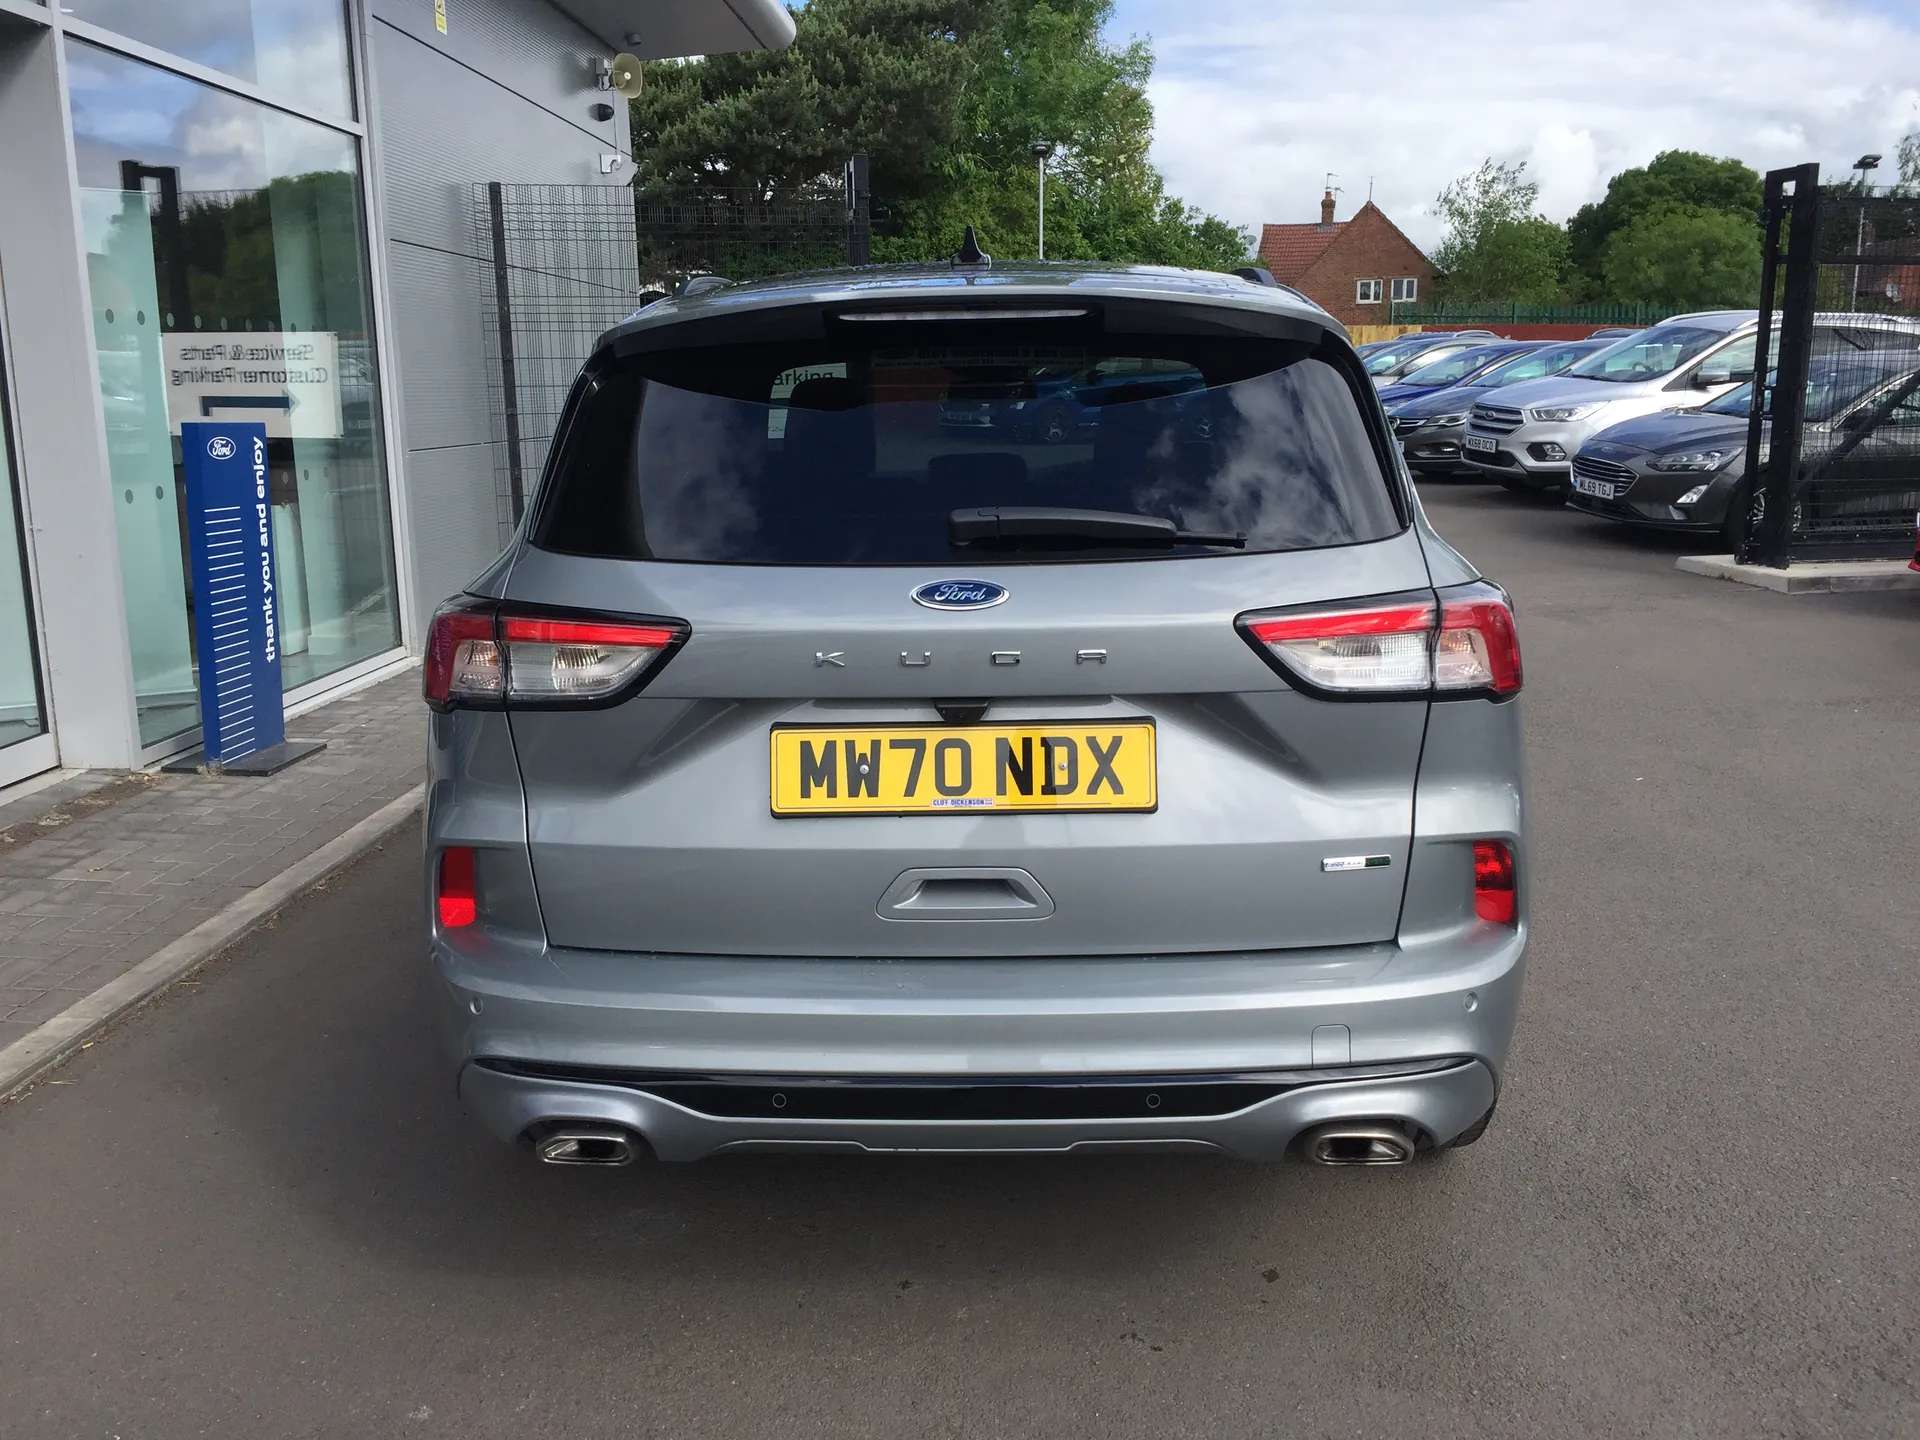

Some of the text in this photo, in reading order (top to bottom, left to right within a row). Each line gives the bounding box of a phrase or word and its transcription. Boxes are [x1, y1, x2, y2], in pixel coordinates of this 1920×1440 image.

[253, 436, 276, 664] thank you and enjoy
[933, 582, 988, 602] Ford
[814, 647, 1109, 668] KUGA
[799, 735, 1125, 800] MW70 NDX
